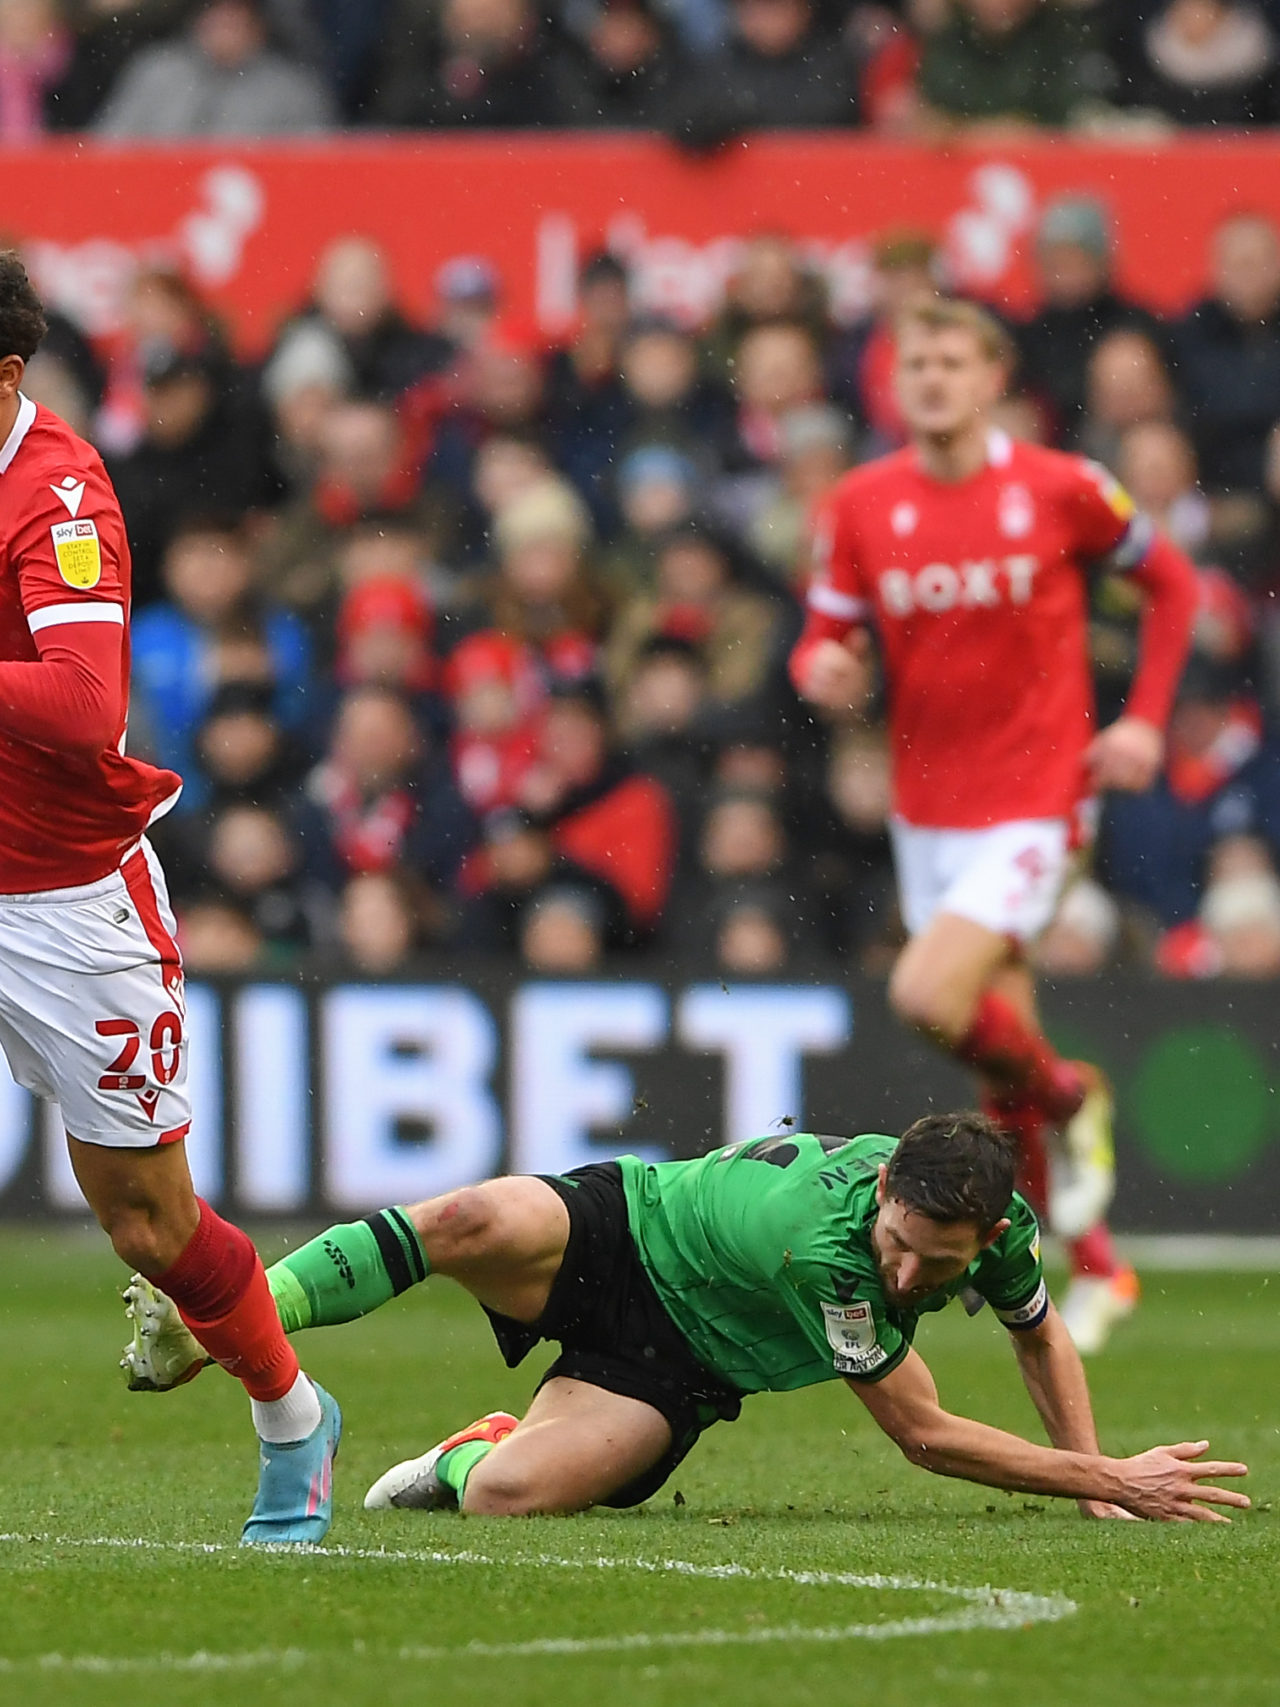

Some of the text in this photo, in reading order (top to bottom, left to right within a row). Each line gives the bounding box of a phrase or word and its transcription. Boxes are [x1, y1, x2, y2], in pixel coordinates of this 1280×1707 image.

[56, 524, 93, 538] sky bet
[63, 549, 94, 557] CONTROL
[878, 554, 1038, 618] BOXT
[95, 1011, 182, 1089] 20
[826, 1308, 866, 1319] sky bet
[845, 1341, 861, 1349] EFL
